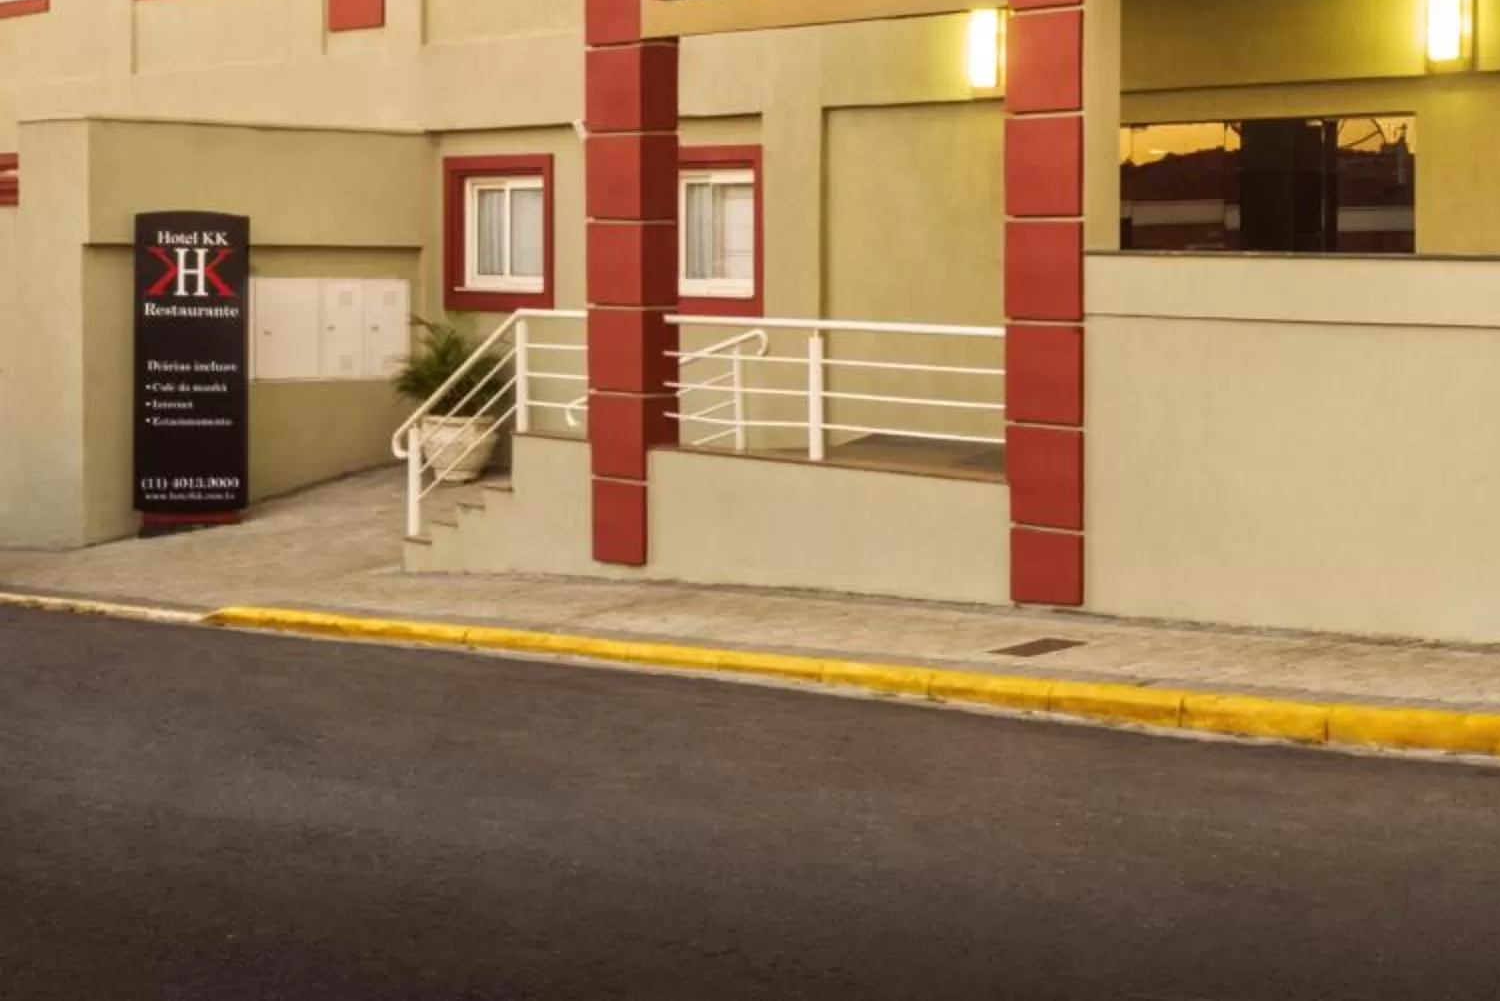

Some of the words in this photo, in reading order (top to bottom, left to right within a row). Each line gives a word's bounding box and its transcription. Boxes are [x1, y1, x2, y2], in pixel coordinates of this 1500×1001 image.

[157, 230, 198, 245] Hotel
[202, 231, 229, 246] KK
[144, 302, 240, 317] Restaurante
[141, 477, 168, 489] (11)
